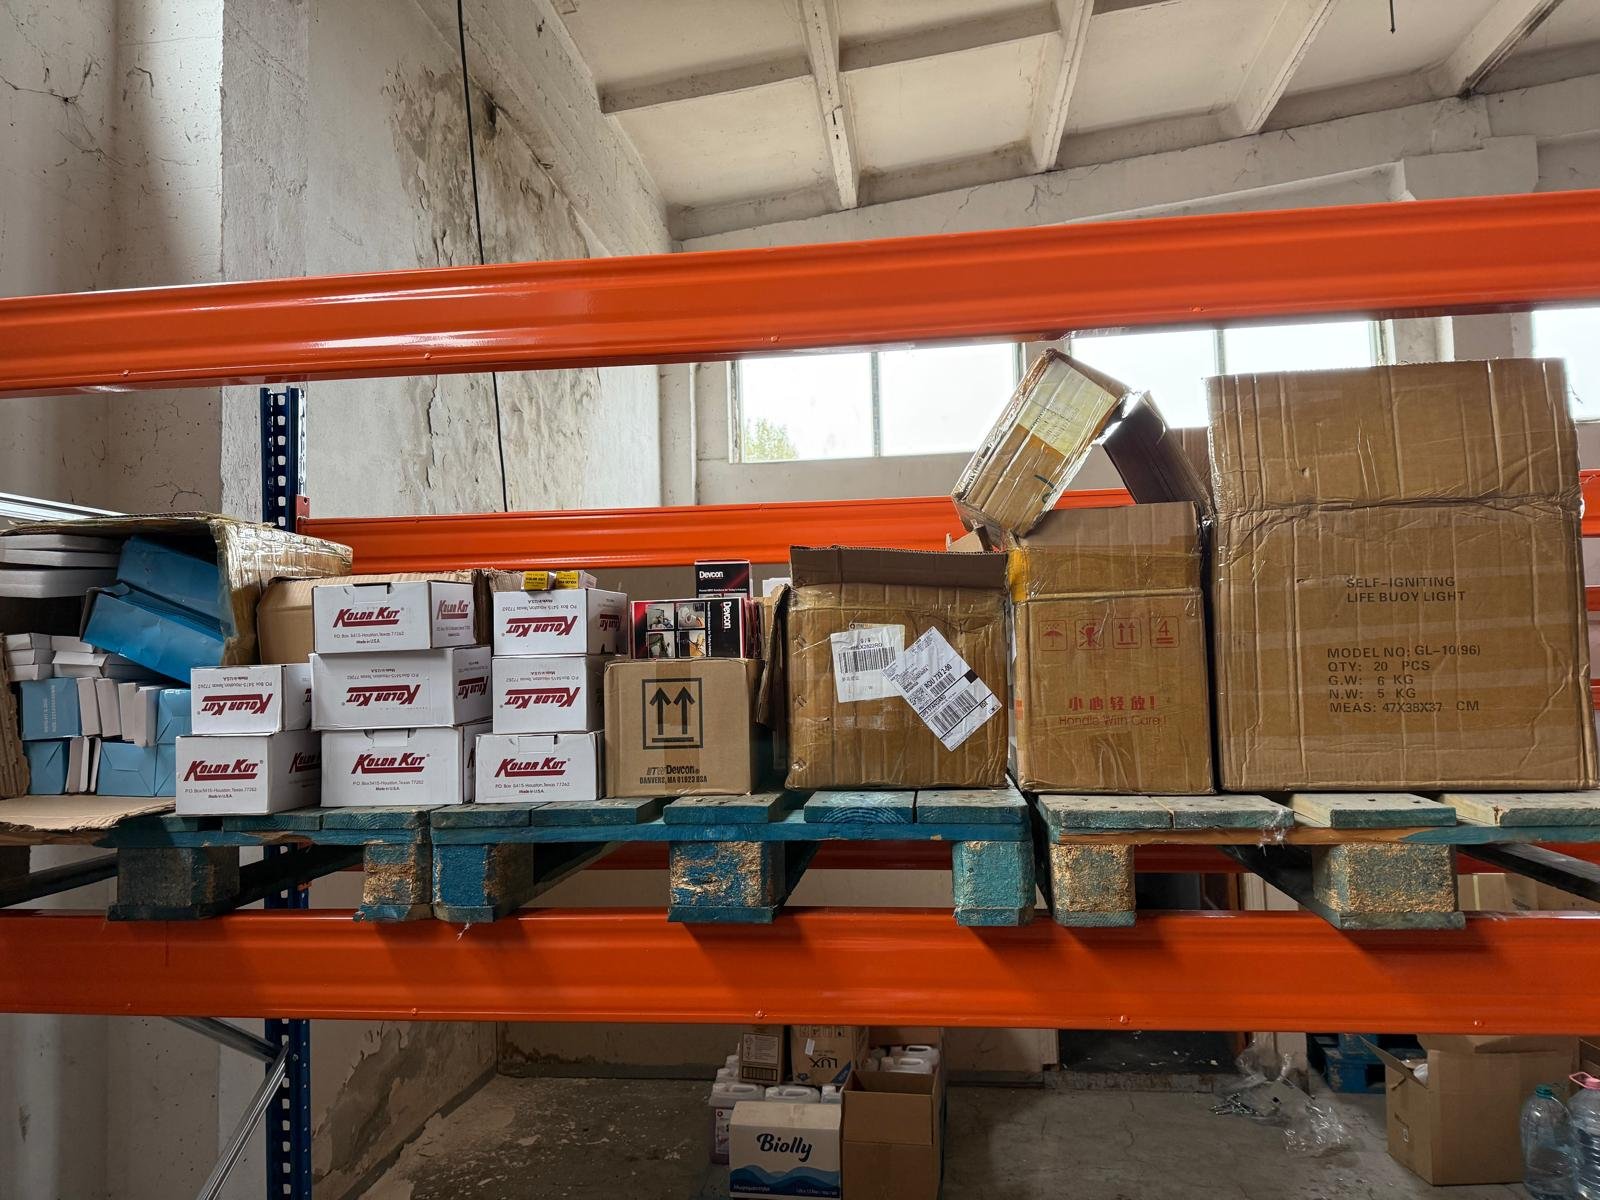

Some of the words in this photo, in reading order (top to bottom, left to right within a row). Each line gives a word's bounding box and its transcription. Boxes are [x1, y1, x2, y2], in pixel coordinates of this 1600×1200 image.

[1346, 577, 1456, 588] SELF-IGNITING
[1347, 592, 1375, 602] LIFE
[1379, 591, 1419, 602] BUOY
[1424, 591, 1465, 602] LIGHT
[333, 609, 372, 628] KOLOR
[723, 601, 731, 628] Devcon
[533, 616, 578, 636] KOLOR
[1327, 648, 1379, 658] MODEL
[1384, 648, 1410, 658] NO:
[1415, 645, 1480, 656] GL-10(96)
[1328, 662, 1362, 672] QTY:
[1374, 661, 1388, 672] 20
[1402, 660, 1430, 671] PCS
[924, 678, 935, 689] ROU
[1328, 676, 1362, 686] G.W:
[1378, 676, 1385, 686] 6
[1394, 674, 1414, 685] KG
[375, 684, 421, 705] KOLOR
[533, 687, 580, 707] KOLOR
[1329, 689, 1363, 699] N.W:
[1378, 689, 1384, 698] 5
[1396, 688, 1416, 698] KG
[228, 694, 273, 714] KOLOR
[1330, 702, 1376, 713] MEAS:
[1383, 702, 1442, 713] 47X38X37
[1456, 701, 1479, 711] CM
[1059, 715, 1099, 725] Handle
[1102, 715, 1128, 725] With
[184, 760, 230, 781] KOLOR
[351, 754, 397, 774] KOLOR
[494, 759, 540, 777] KOLOR
[756, 1134, 812, 1162] Biolly
